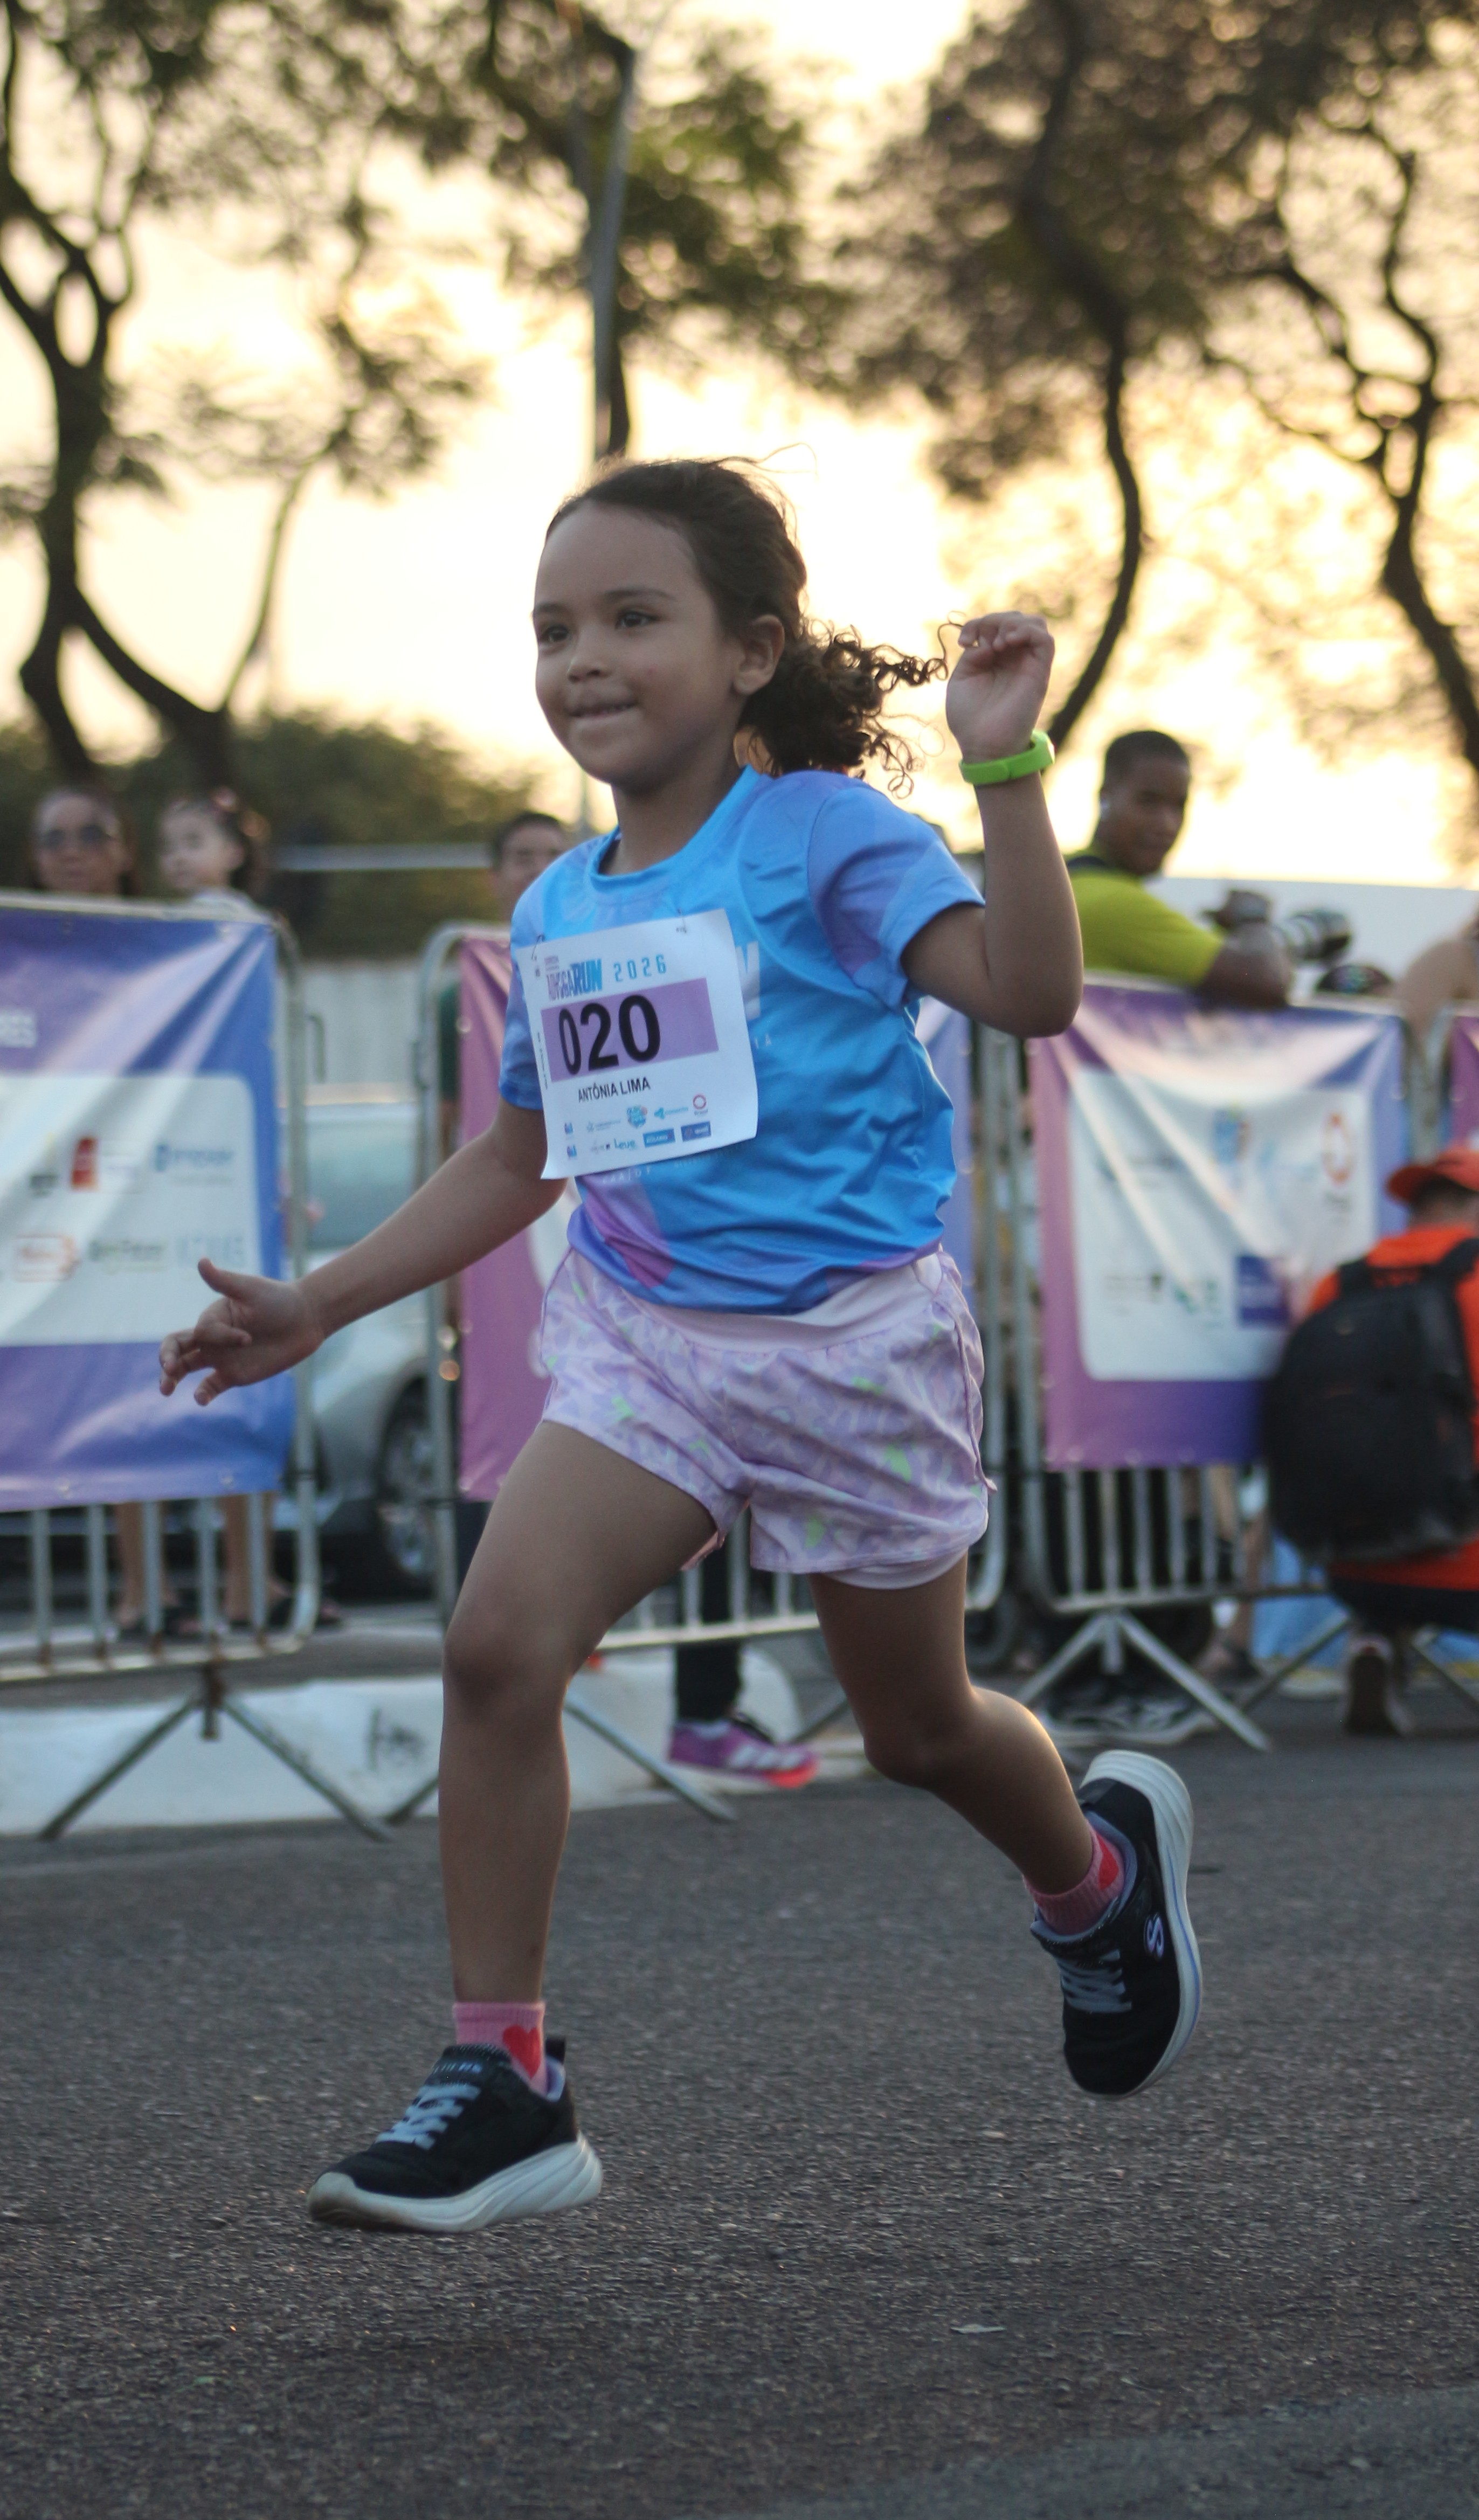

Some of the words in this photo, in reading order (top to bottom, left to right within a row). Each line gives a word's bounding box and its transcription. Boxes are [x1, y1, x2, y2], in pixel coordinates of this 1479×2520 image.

[613, 953, 666, 982] 2026
[559, 995, 660, 1074] 020
[578, 1082, 619, 1103] ANTÔNIA
[620, 1077, 651, 1095] LIMA
